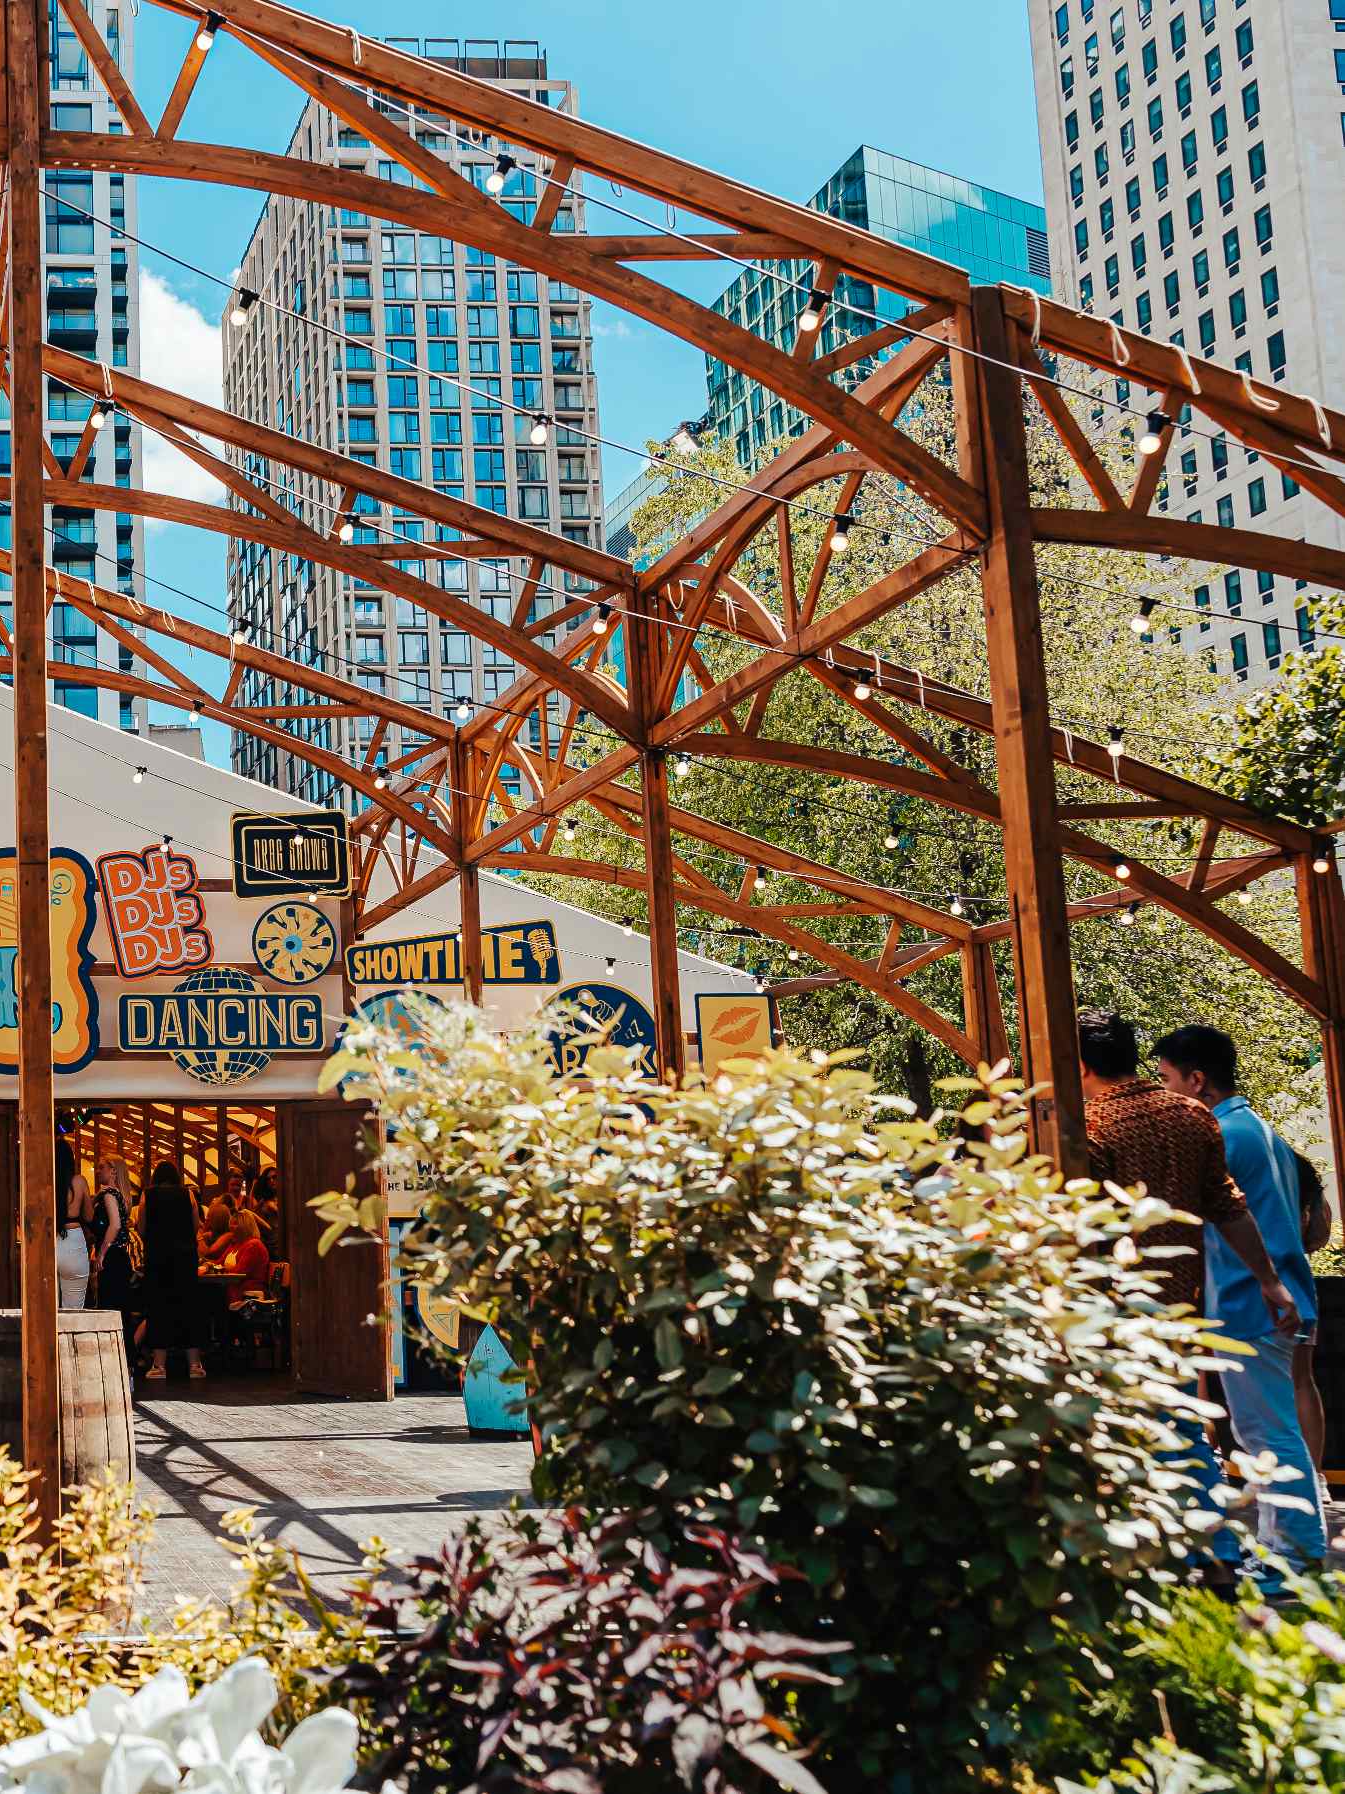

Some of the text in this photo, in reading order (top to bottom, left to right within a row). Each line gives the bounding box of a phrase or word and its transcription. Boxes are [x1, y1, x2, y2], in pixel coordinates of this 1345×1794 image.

[103, 853, 192, 898] DJs
[253, 838, 328, 871] DRAG SHOWS
[113, 888, 199, 936] DJs
[120, 925, 207, 972] DJs
[127, 998, 317, 1046] DANCING
